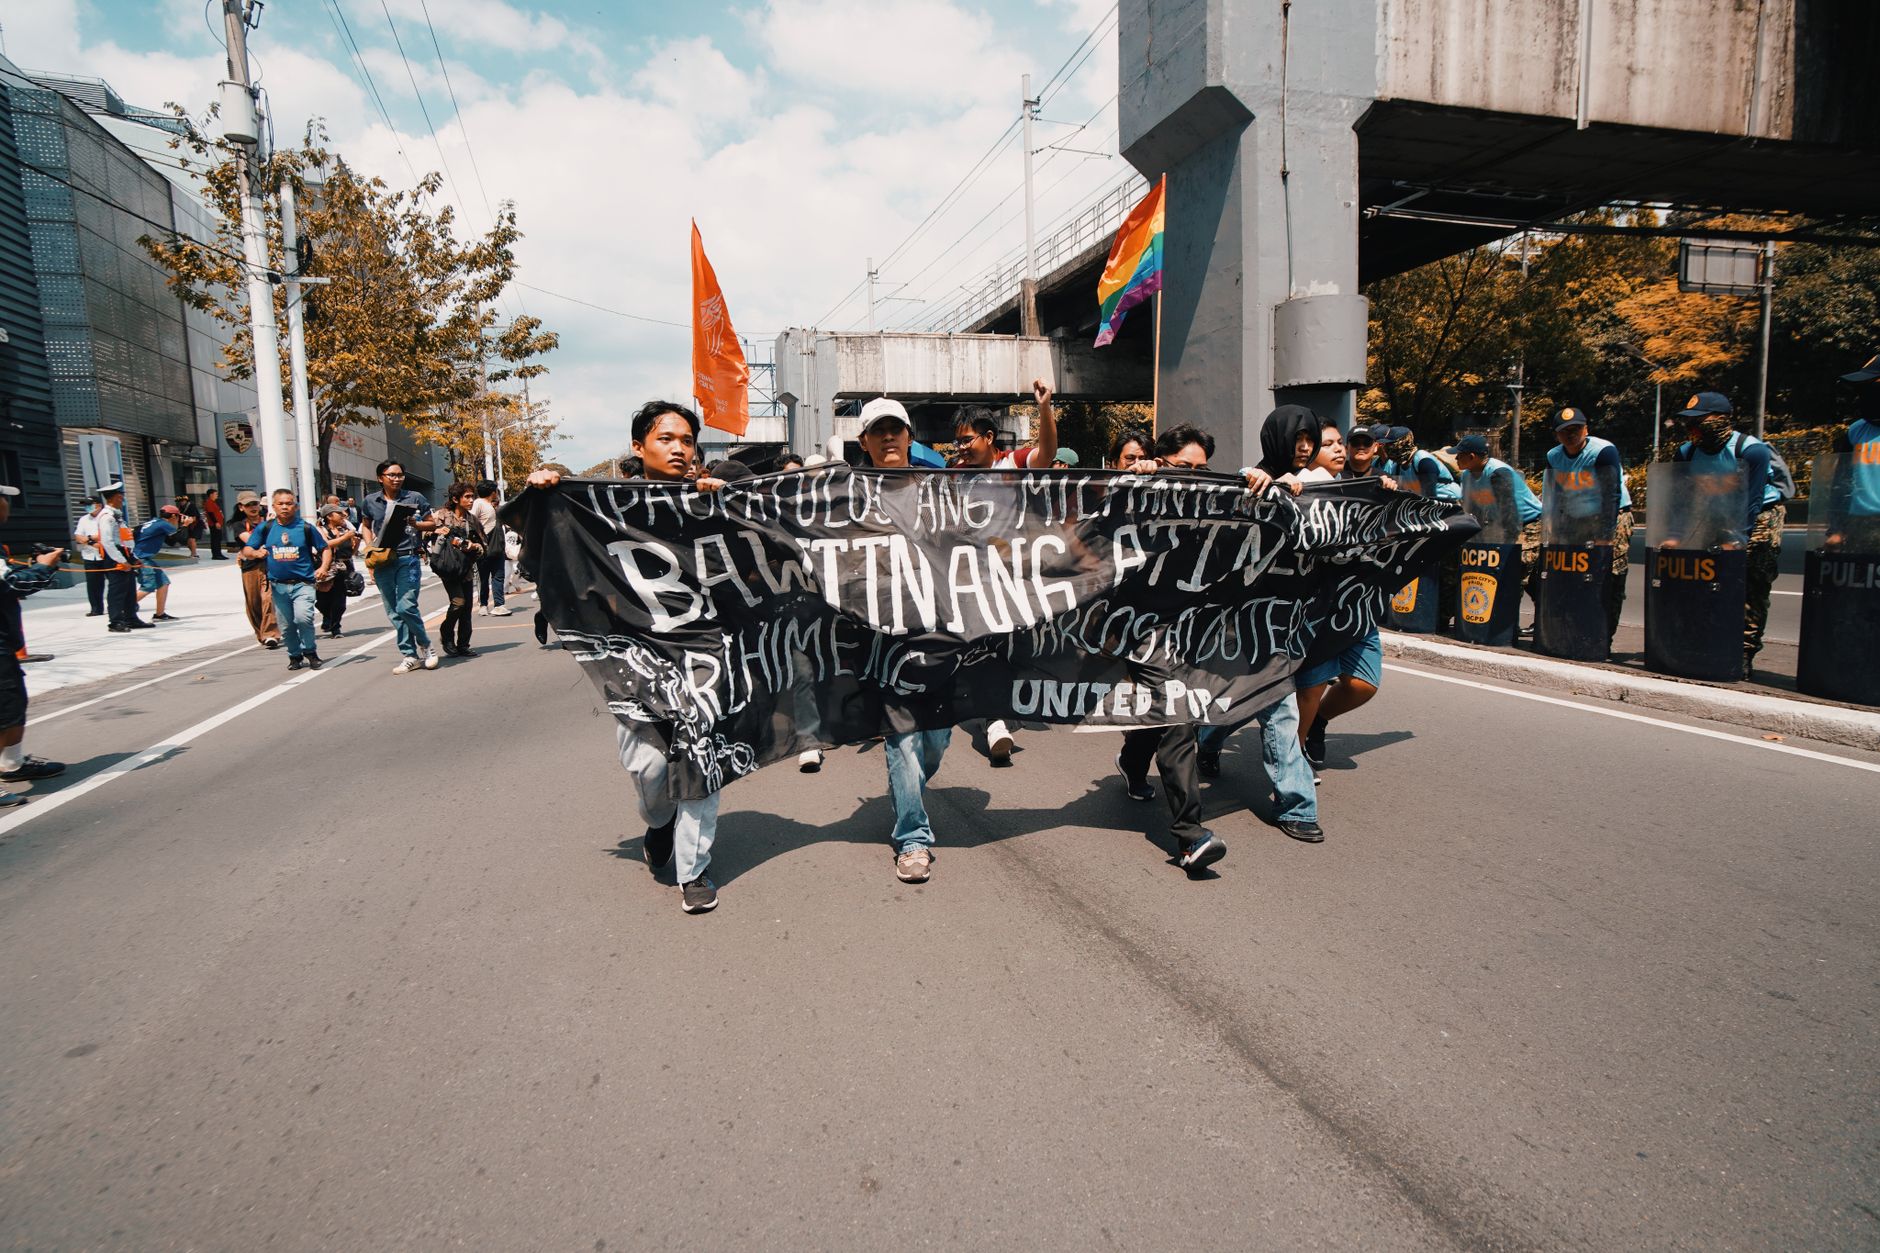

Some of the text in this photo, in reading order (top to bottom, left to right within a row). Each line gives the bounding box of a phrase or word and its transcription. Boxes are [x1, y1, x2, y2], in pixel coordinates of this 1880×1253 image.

[913, 474, 994, 533] ANG
[1461, 548, 1500, 567] QCPD
[1545, 552, 1589, 573] PULIS
[1656, 556, 1716, 581] PULIS
[947, 535, 1077, 633] ANG
[1820, 562, 1880, 589] PULI
[1465, 614, 1485, 622] QCPD
[1012, 679, 1212, 723] UNITED PUP
